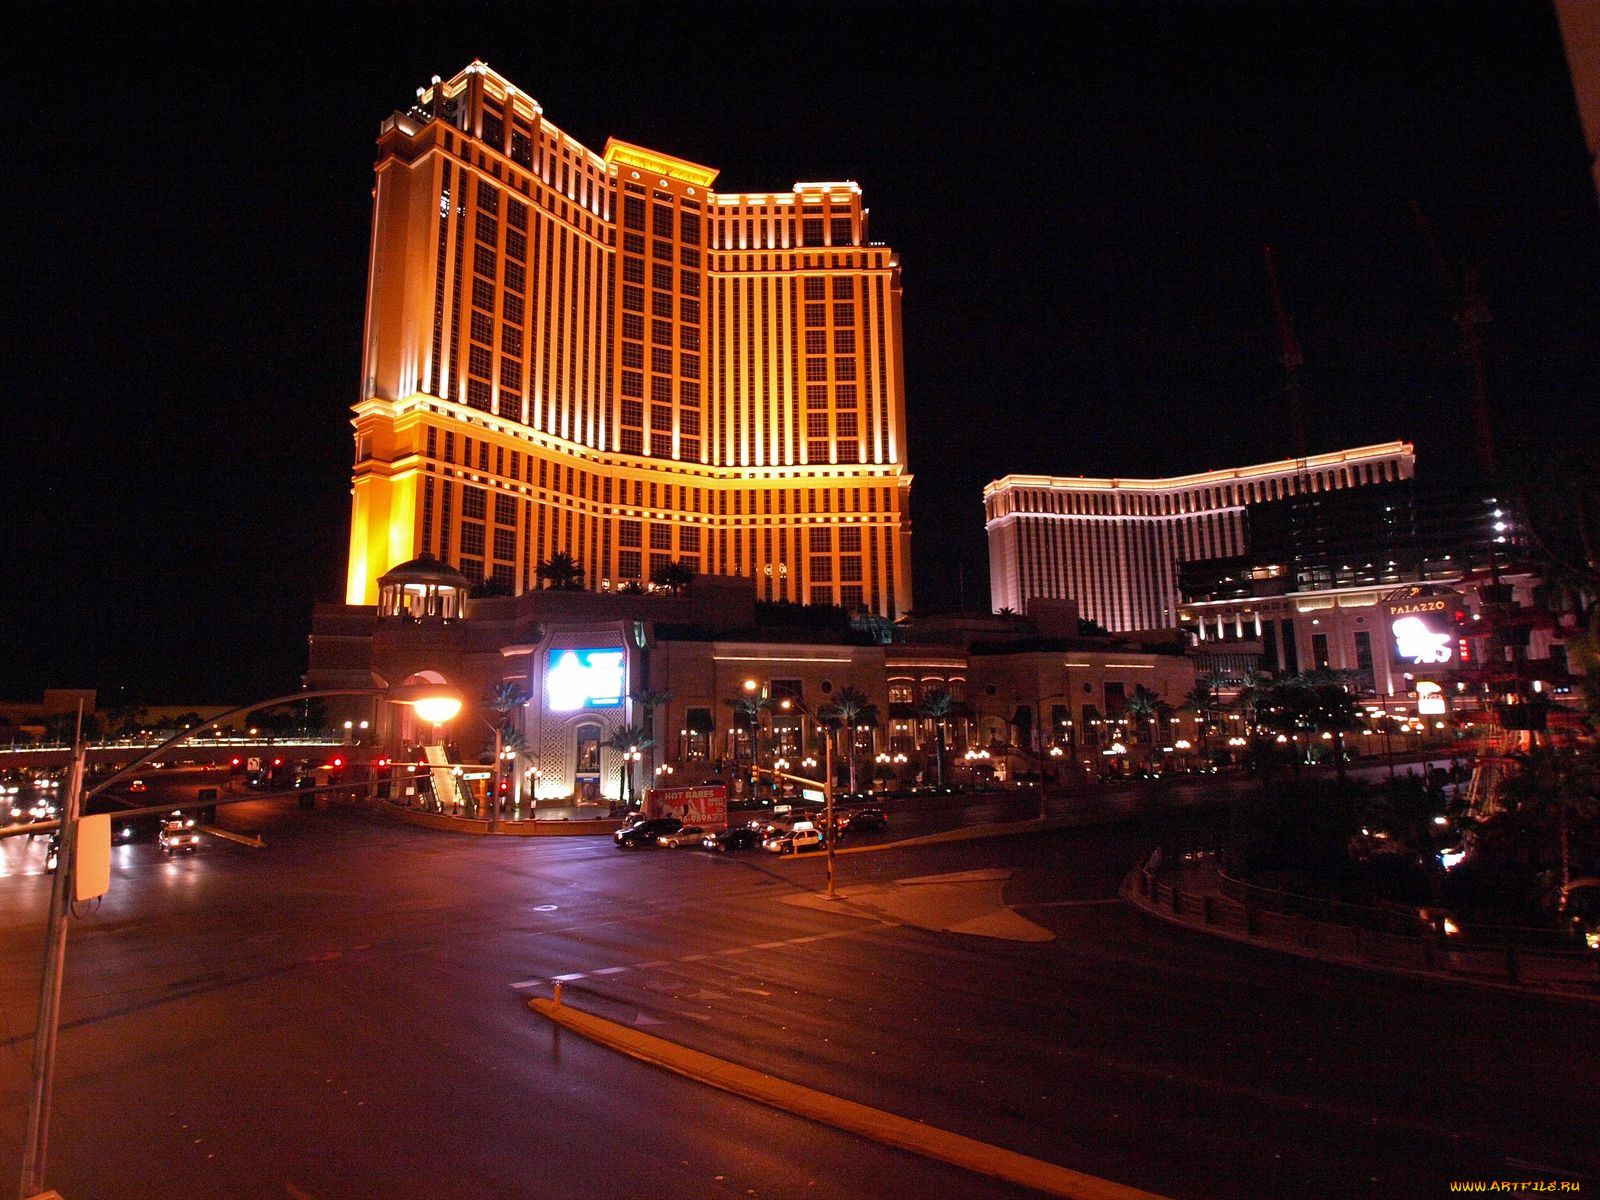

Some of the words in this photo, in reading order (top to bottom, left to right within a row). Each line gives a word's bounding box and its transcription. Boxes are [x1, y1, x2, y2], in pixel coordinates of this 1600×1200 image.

[1390, 601, 1445, 615] PALAZZO
[665, 791, 683, 800] HOT
[685, 790, 714, 799] BABES
